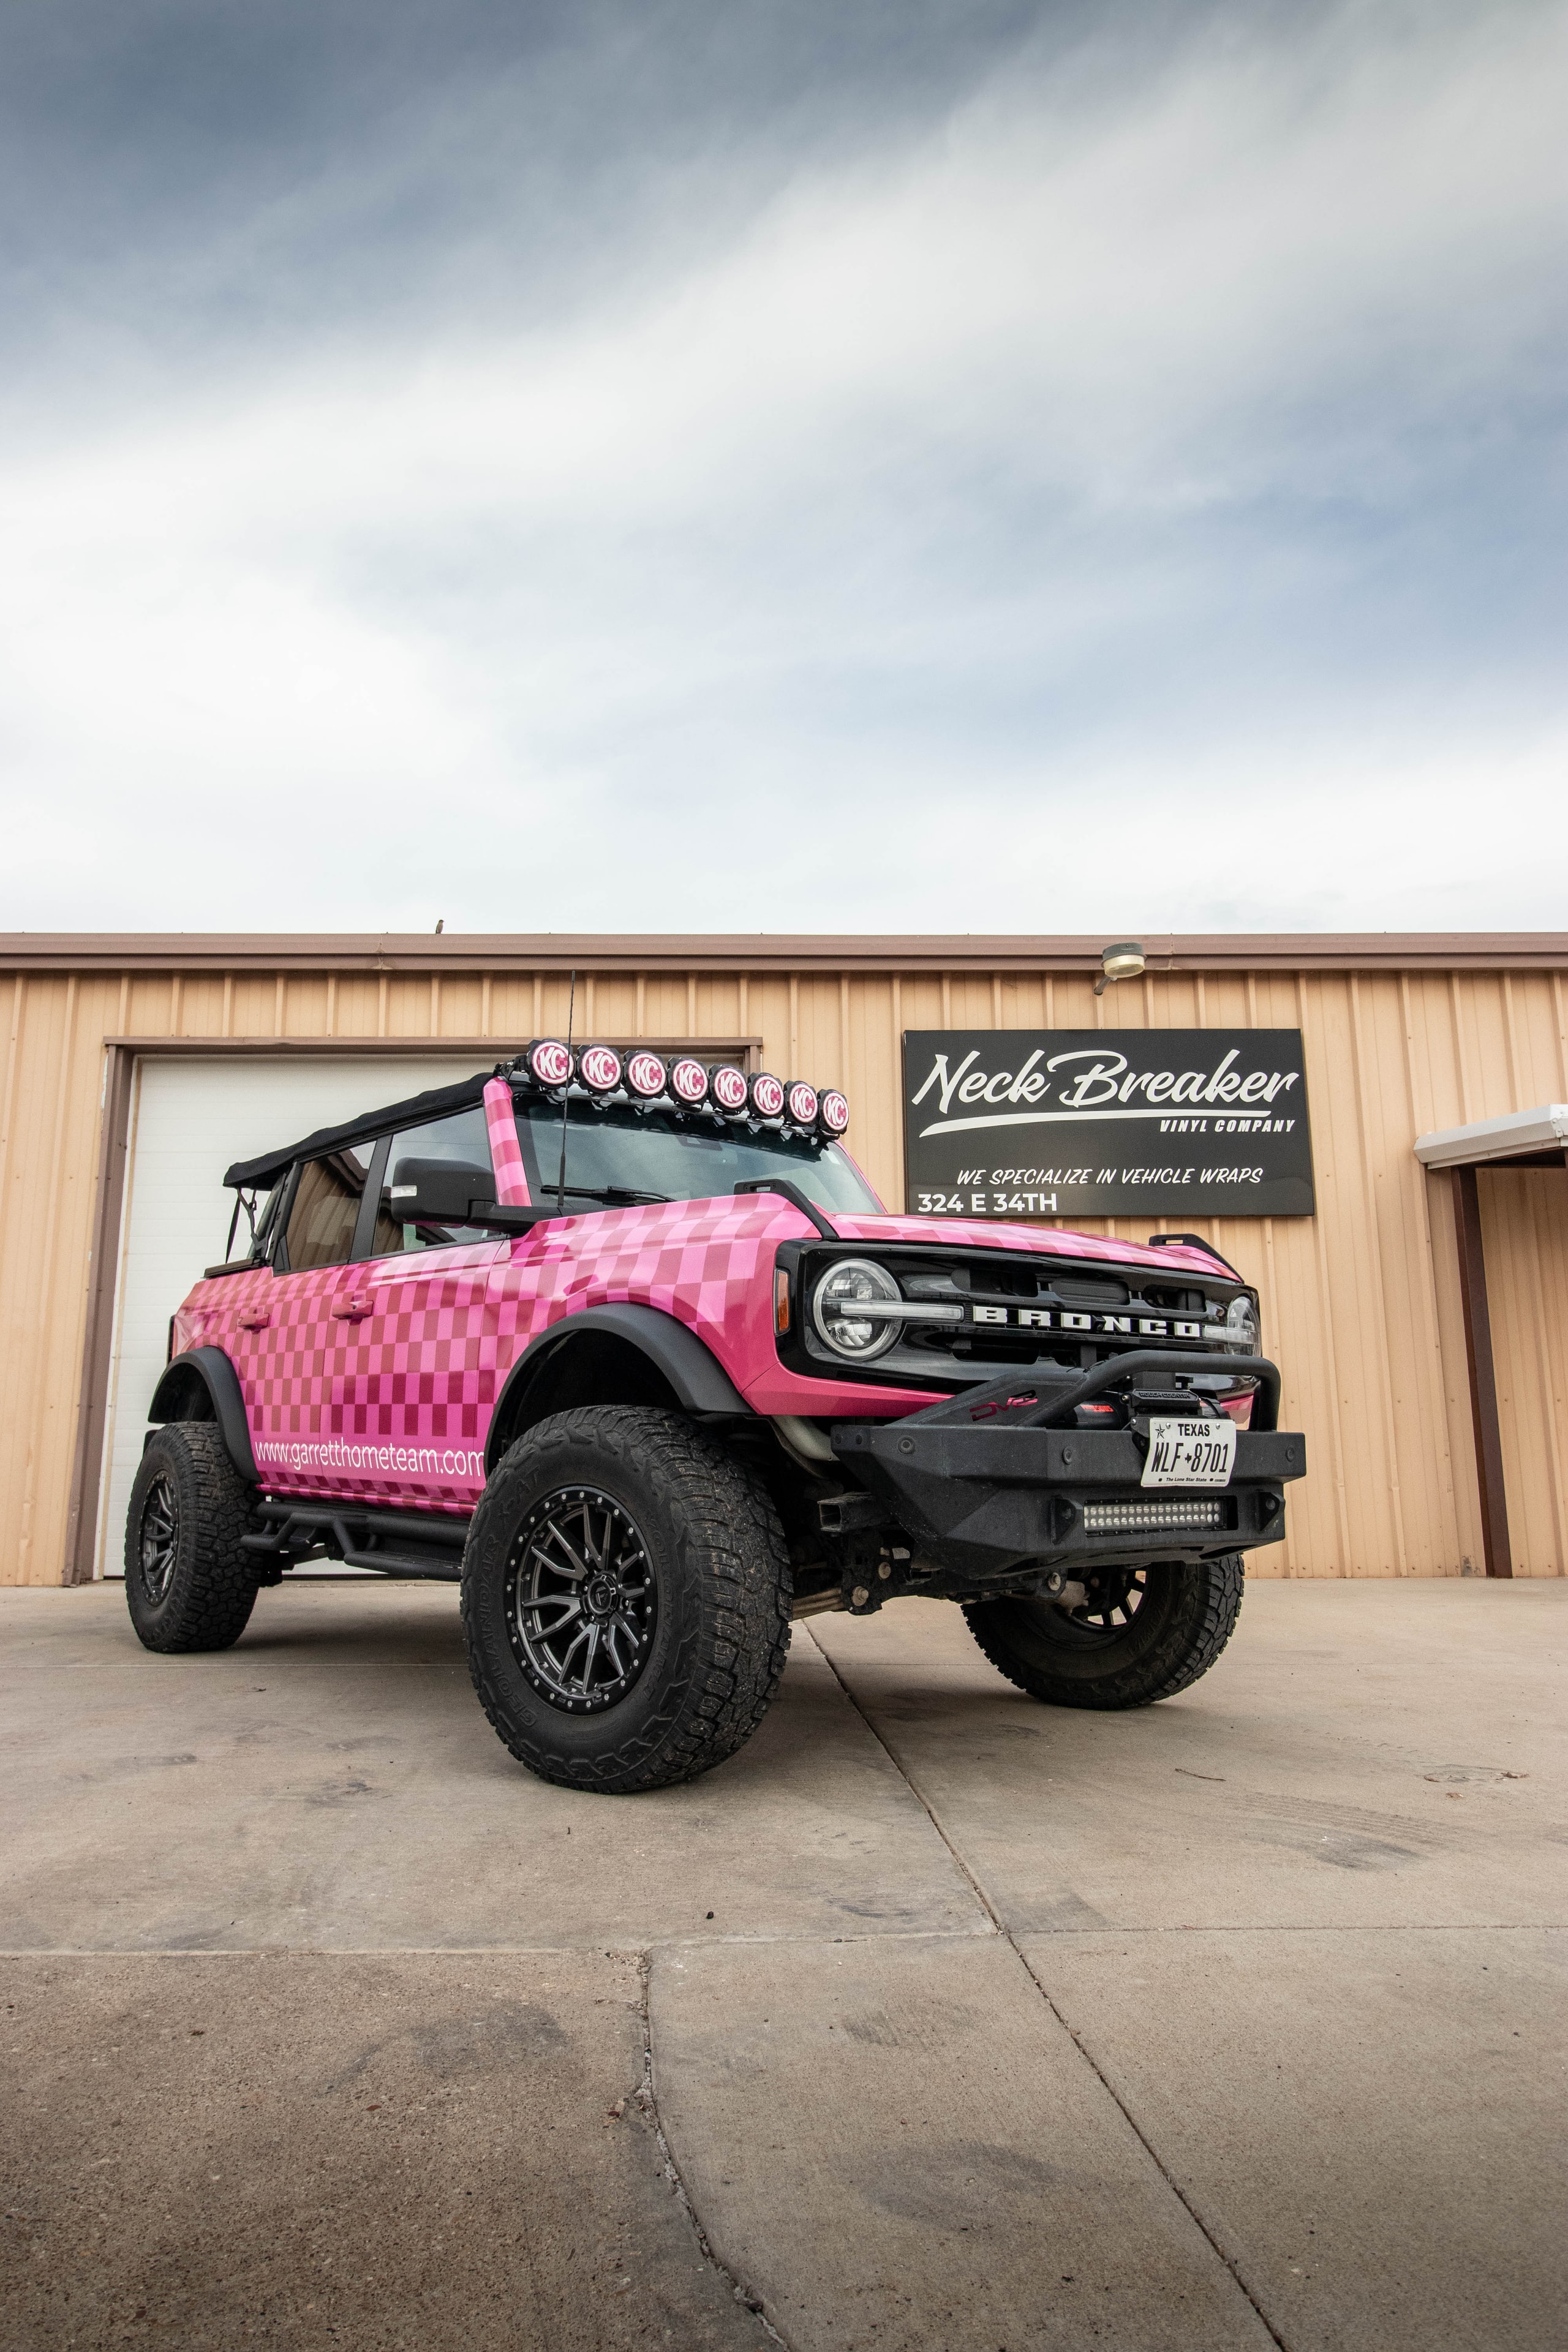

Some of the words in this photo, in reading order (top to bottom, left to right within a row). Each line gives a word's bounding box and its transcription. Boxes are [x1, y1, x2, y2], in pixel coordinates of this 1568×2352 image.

[540, 1047, 565, 1078] KC
[589, 1052, 613, 1083] KC
[635, 1058, 659, 1088] KC
[679, 1065, 701, 1095] KC
[720, 1072, 741, 1102] KC
[759, 1080, 778, 1109] KC
[912, 1049, 1052, 1114] Neck
[1047, 1049, 1299, 1108] Breaker
[795, 1088, 813, 1117] KC
[827, 1097, 843, 1125] KC
[1160, 1120, 1207, 1133] VINYL
[1214, 1120, 1295, 1133] COMPANY
[957, 1169, 987, 1185] WE
[989, 1169, 1093, 1185] SPECIALIZE
[1096, 1169, 1117, 1184] IN
[1121, 1168, 1196, 1184] VEHICLE
[1199, 1167, 1264, 1184] WRAPS
[918, 1194, 964, 1212] 324
[971, 1194, 987, 1212] E
[993, 1193, 1057, 1212] 34TH
[972, 1306, 1200, 1338] BRONCO
[1178, 1423, 1210, 1437] TEXAS
[255, 1437, 484, 1477] www.garretthometeam.com
[1151, 1442, 1184, 1472] WLF
[1190, 1443, 1229, 1472] 8701
[478, 1534, 537, 1728] GEOLANDAR
